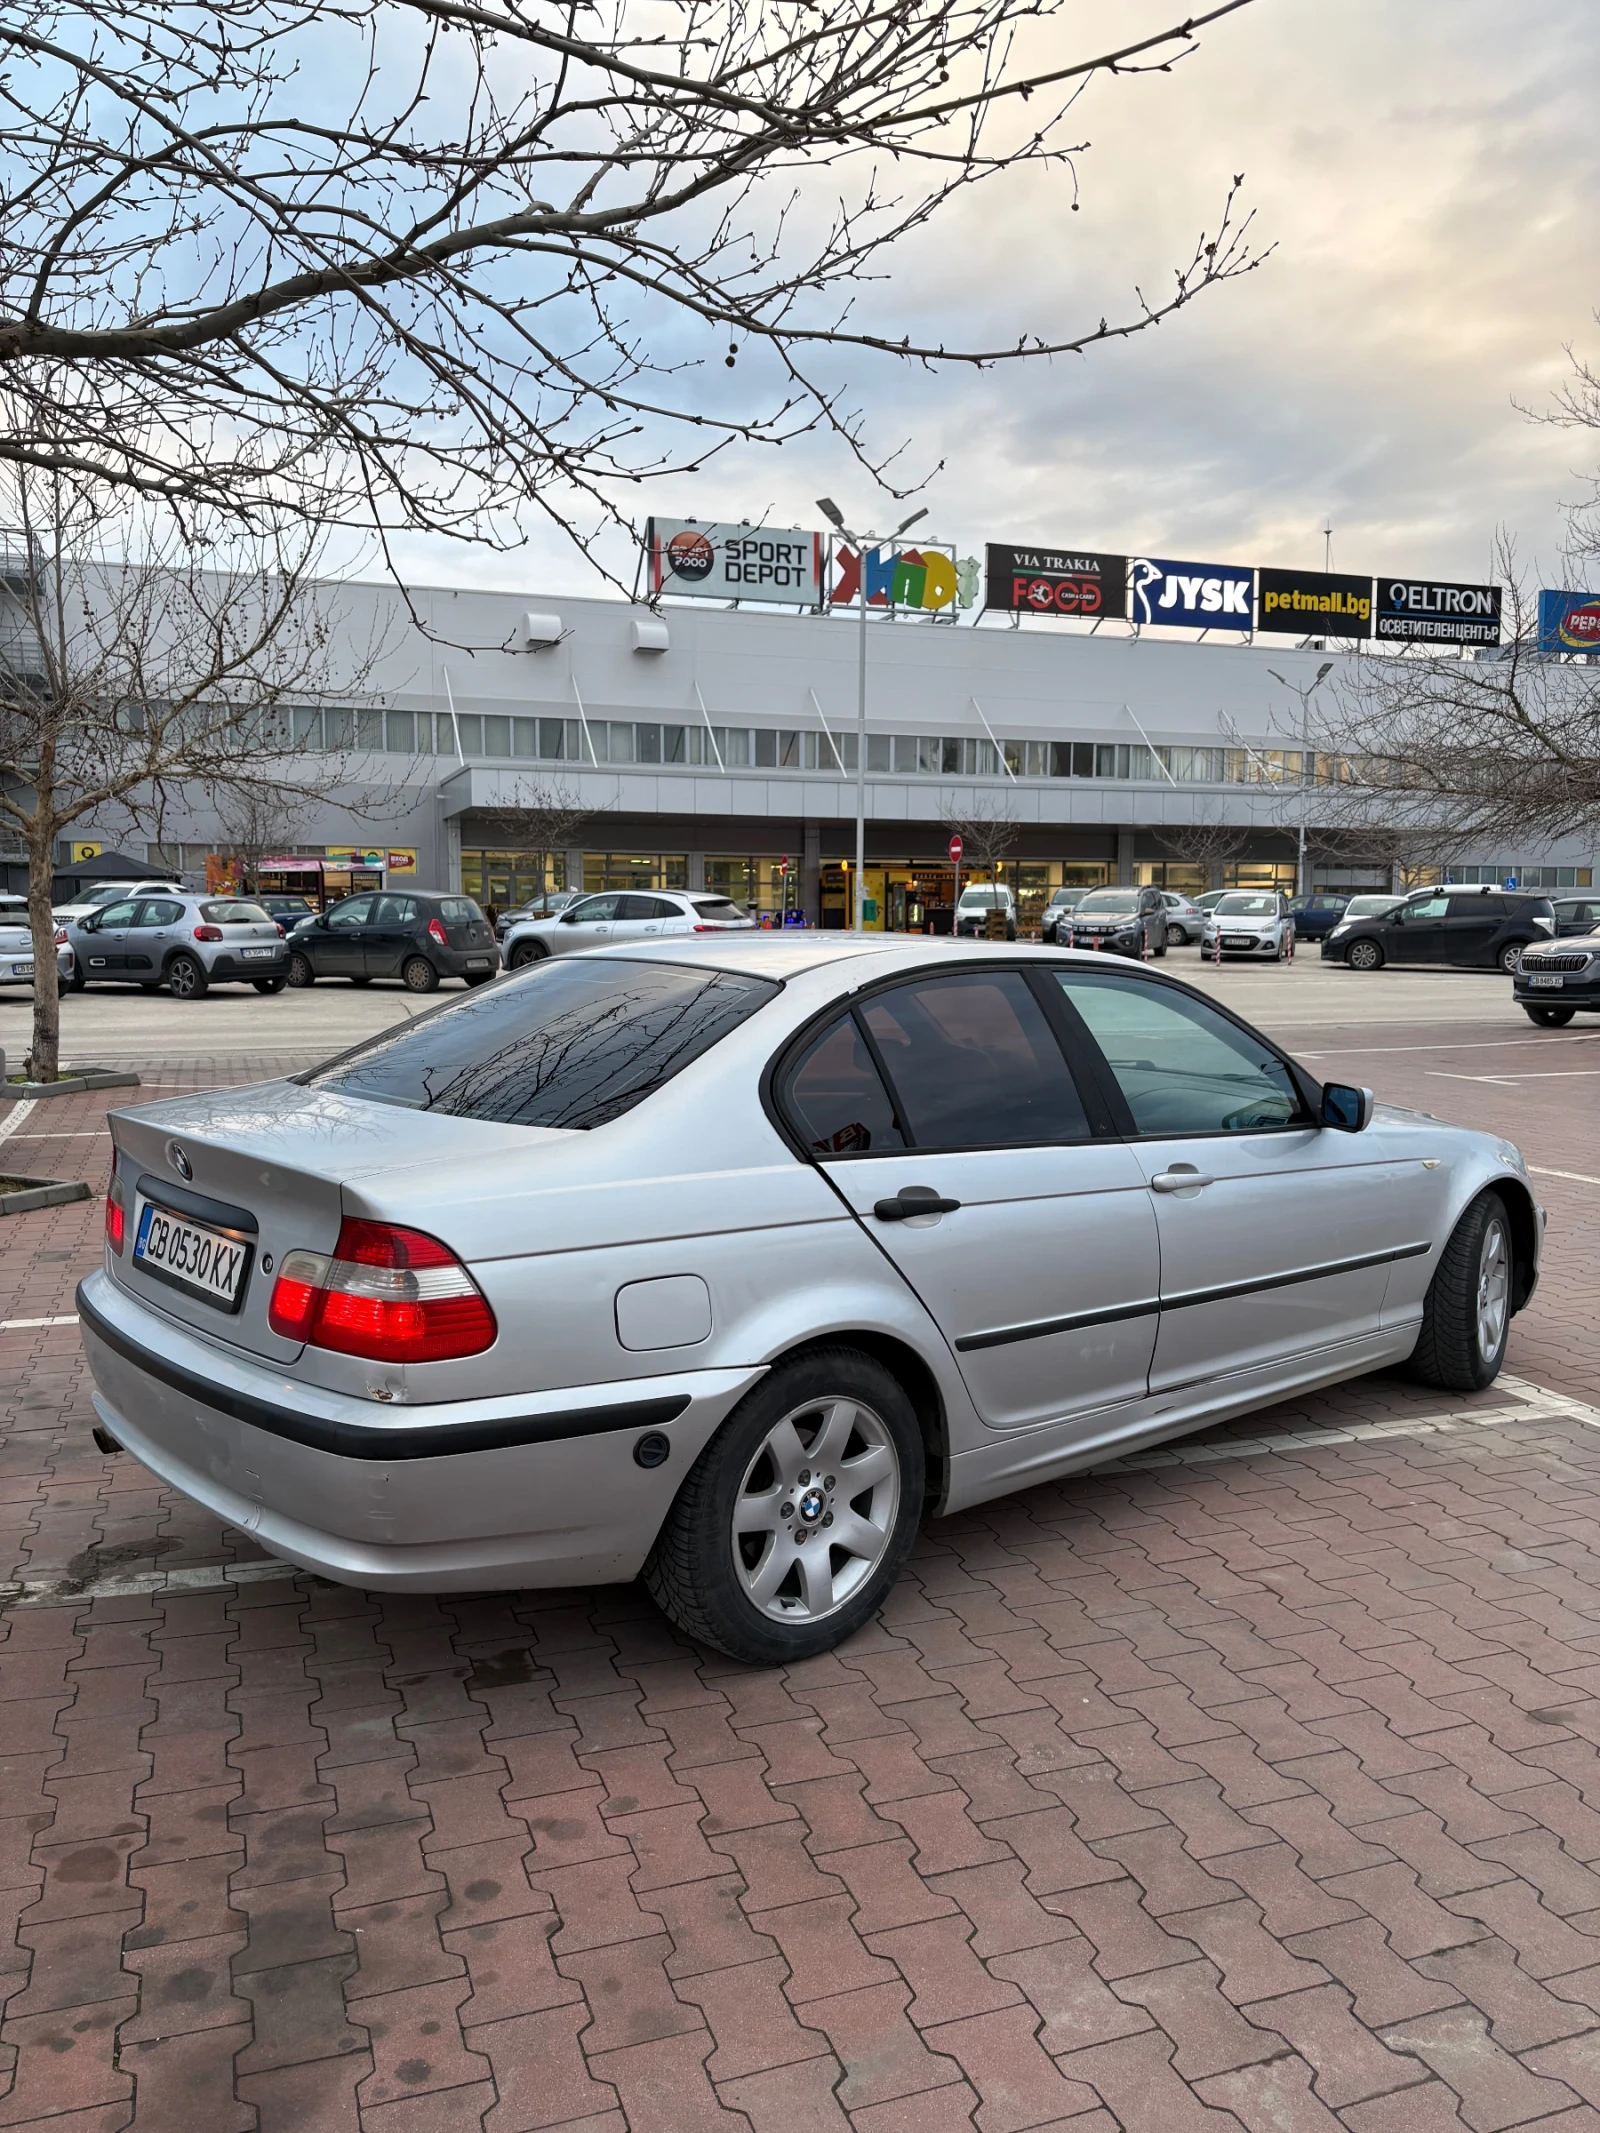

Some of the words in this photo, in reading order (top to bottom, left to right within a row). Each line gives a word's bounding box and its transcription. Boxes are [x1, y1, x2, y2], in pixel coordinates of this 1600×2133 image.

[675, 556, 707, 568] 2000
[725, 539, 807, 565] SPORT
[1013, 553, 1040, 567] VIA
[1043, 556, 1100, 572] TRAKIA
[725, 562, 806, 588] DEPOT
[1012, 578, 1102, 612] FOOD
[1158, 575, 1250, 614] JYSK
[1264, 590, 1370, 620] petmall.bg
[1380, 618, 1454, 638] ОСВЕТИТЕЛЕН
[1455, 623, 1499, 641] ЦЕНТЪР
